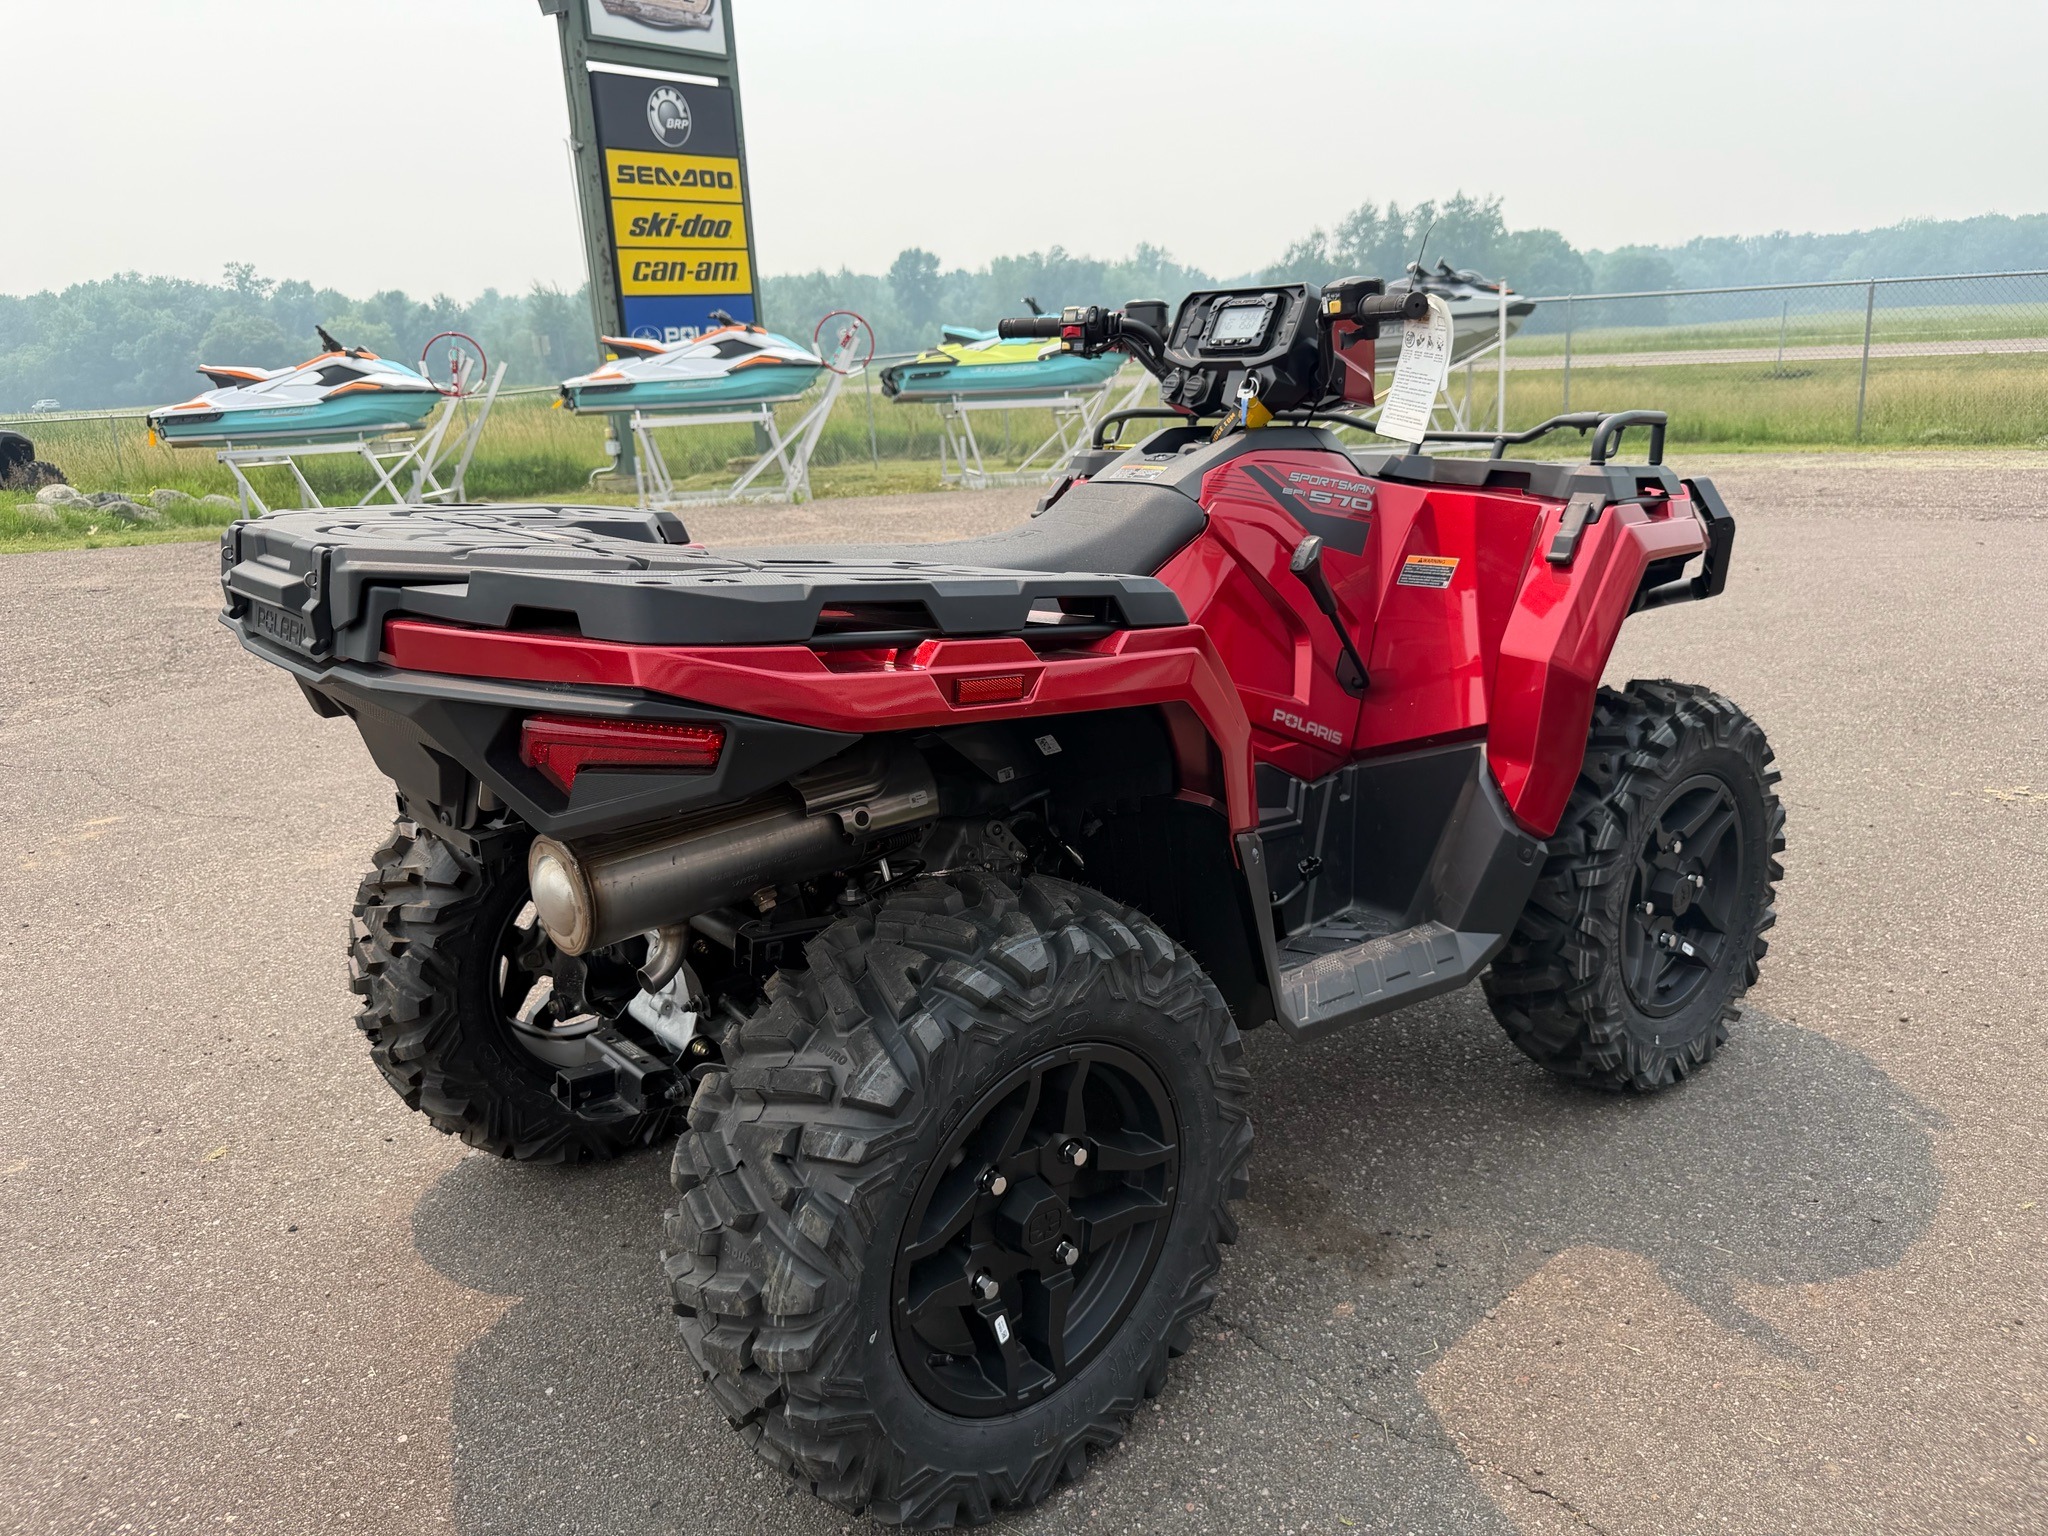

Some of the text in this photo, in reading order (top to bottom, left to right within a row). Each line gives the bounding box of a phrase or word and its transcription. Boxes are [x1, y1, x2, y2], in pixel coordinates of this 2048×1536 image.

[666, 118, 689, 130] BRP
[630, 212, 732, 238] ski-doo
[632, 261, 738, 282] can-am
[1289, 471, 1376, 495] SPORTSMAN
[1282, 487, 1373, 512] EFI 570
[1272, 708, 1343, 746] POLARIS
